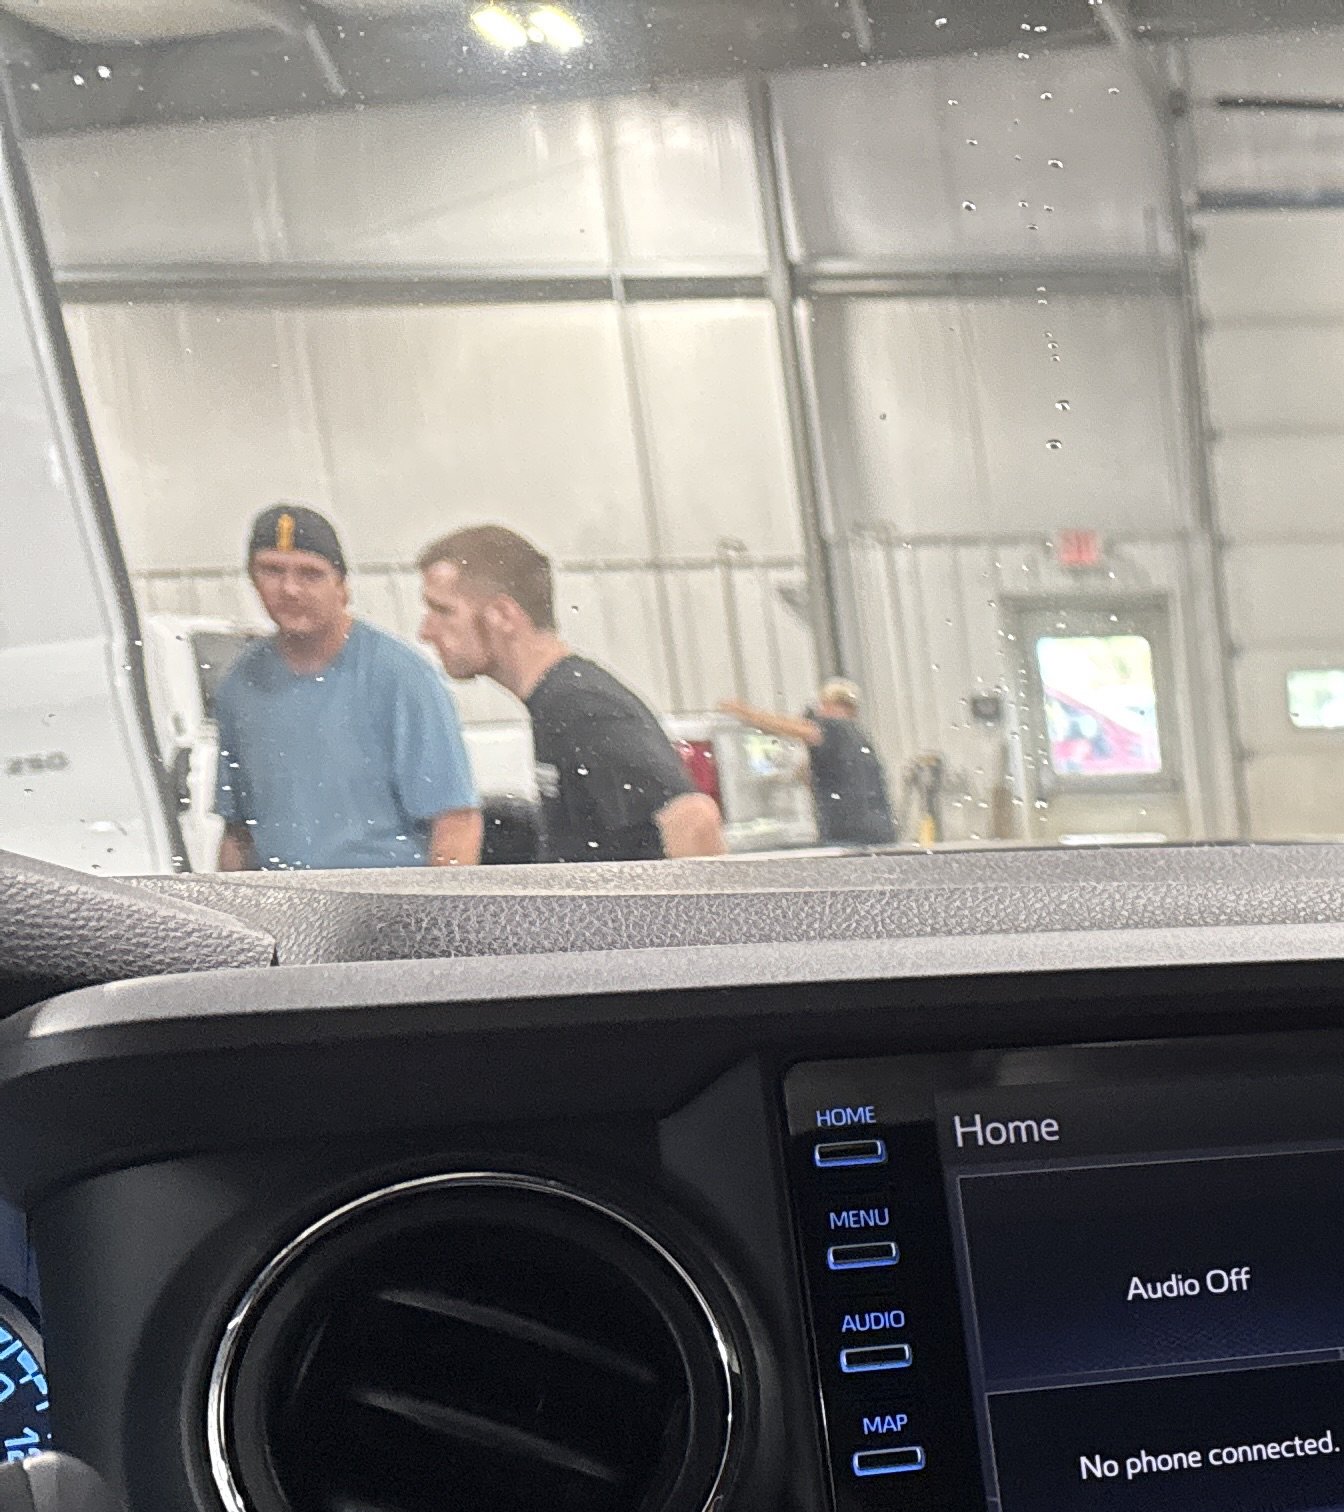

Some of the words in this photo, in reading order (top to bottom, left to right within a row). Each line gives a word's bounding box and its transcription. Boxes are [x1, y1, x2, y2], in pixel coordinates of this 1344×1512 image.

[817, 1106, 875, 1126] HOME
[954, 1114, 1059, 1147] Home
[830, 1208, 889, 1229] MENU
[1128, 1274, 1200, 1300] Audio
[1206, 1267, 1251, 1293] Off
[842, 1310, 904, 1332] AUDIO
[863, 1414, 907, 1434] MAP
[1080, 1455, 1118, 1479] No
[1126, 1450, 1202, 1479] phone
[1209, 1430, 1339, 1465] connected.
